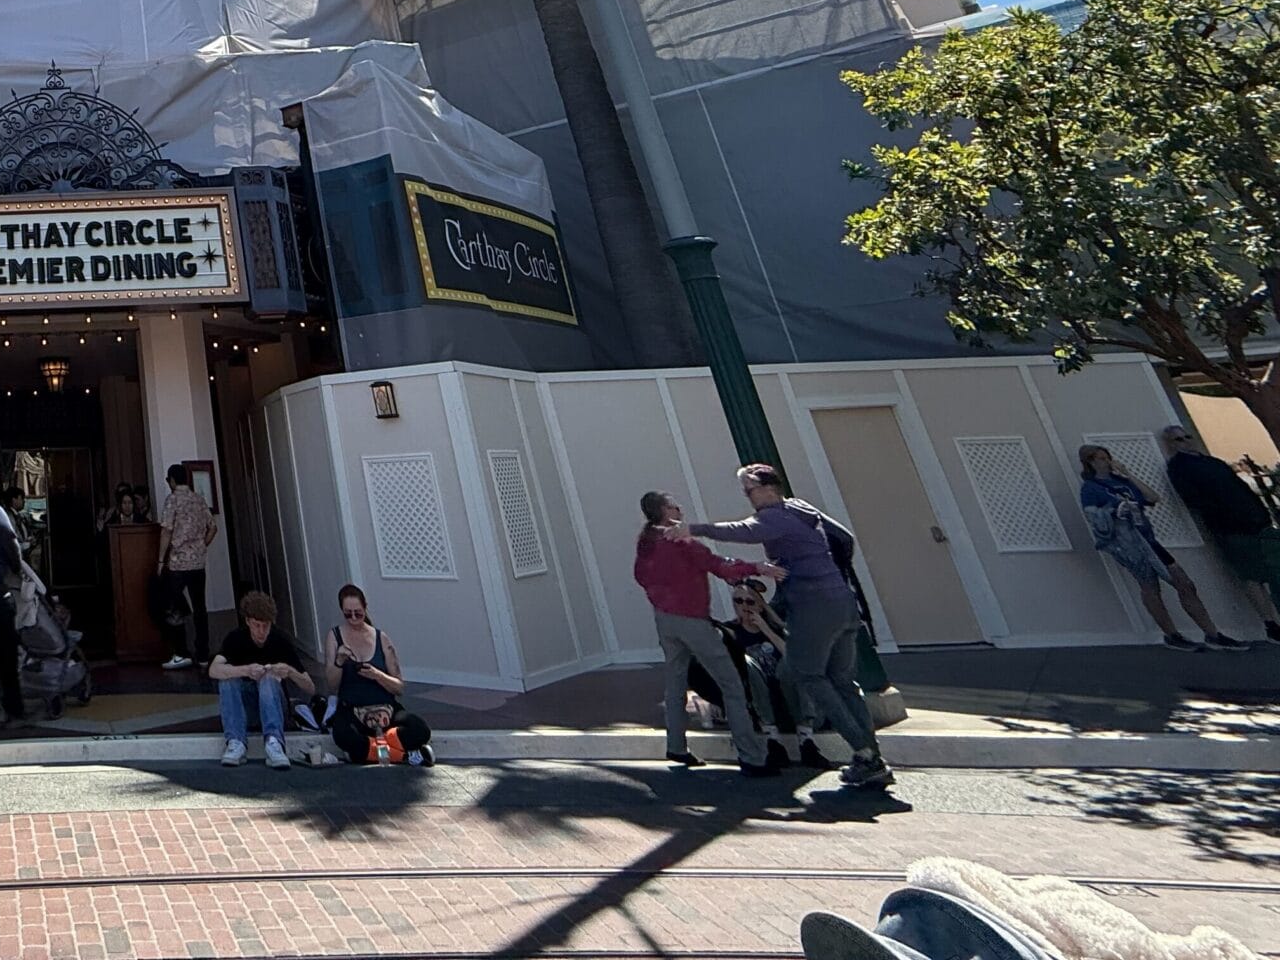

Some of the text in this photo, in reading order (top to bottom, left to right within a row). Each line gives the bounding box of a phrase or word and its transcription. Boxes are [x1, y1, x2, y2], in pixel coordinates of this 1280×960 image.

[84, 217, 193, 247] CIRCLE
[444, 218, 558, 284] Carthay Circle
[91, 252, 198, 281] DINING
